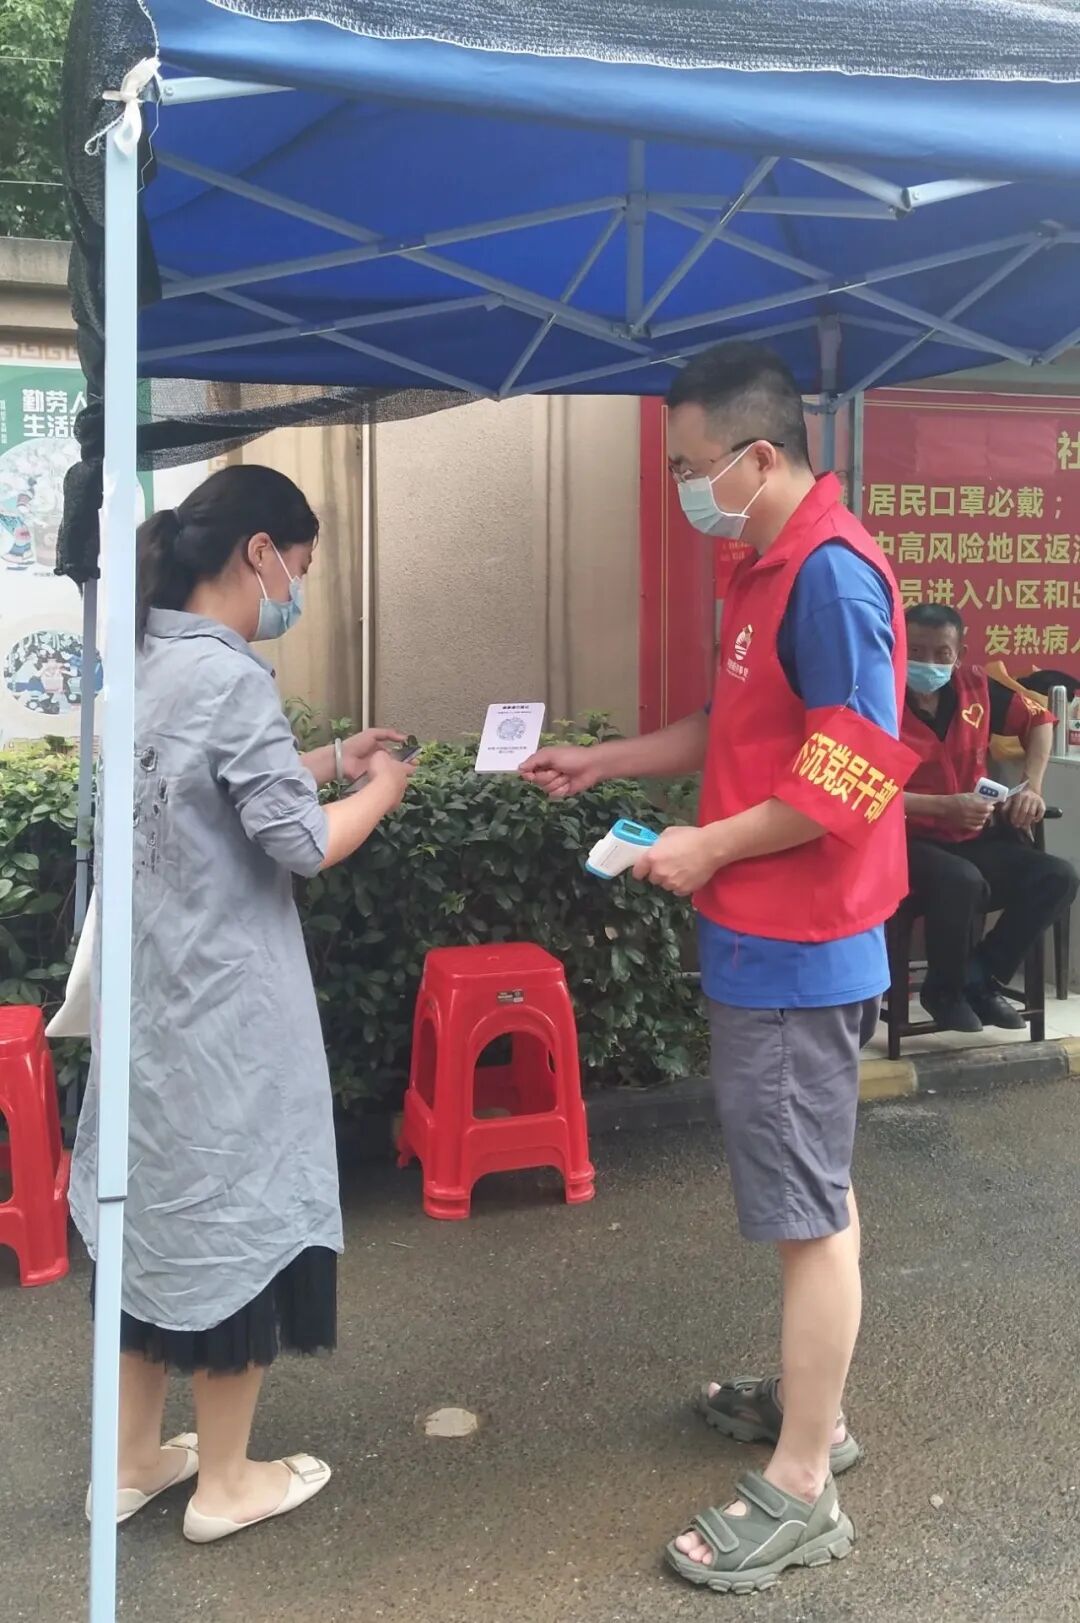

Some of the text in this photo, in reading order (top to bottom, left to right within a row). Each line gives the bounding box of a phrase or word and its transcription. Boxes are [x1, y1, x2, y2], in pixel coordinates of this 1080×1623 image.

[22, 388, 88, 414] 勤劳人
[23, 414, 76, 438] 生活
